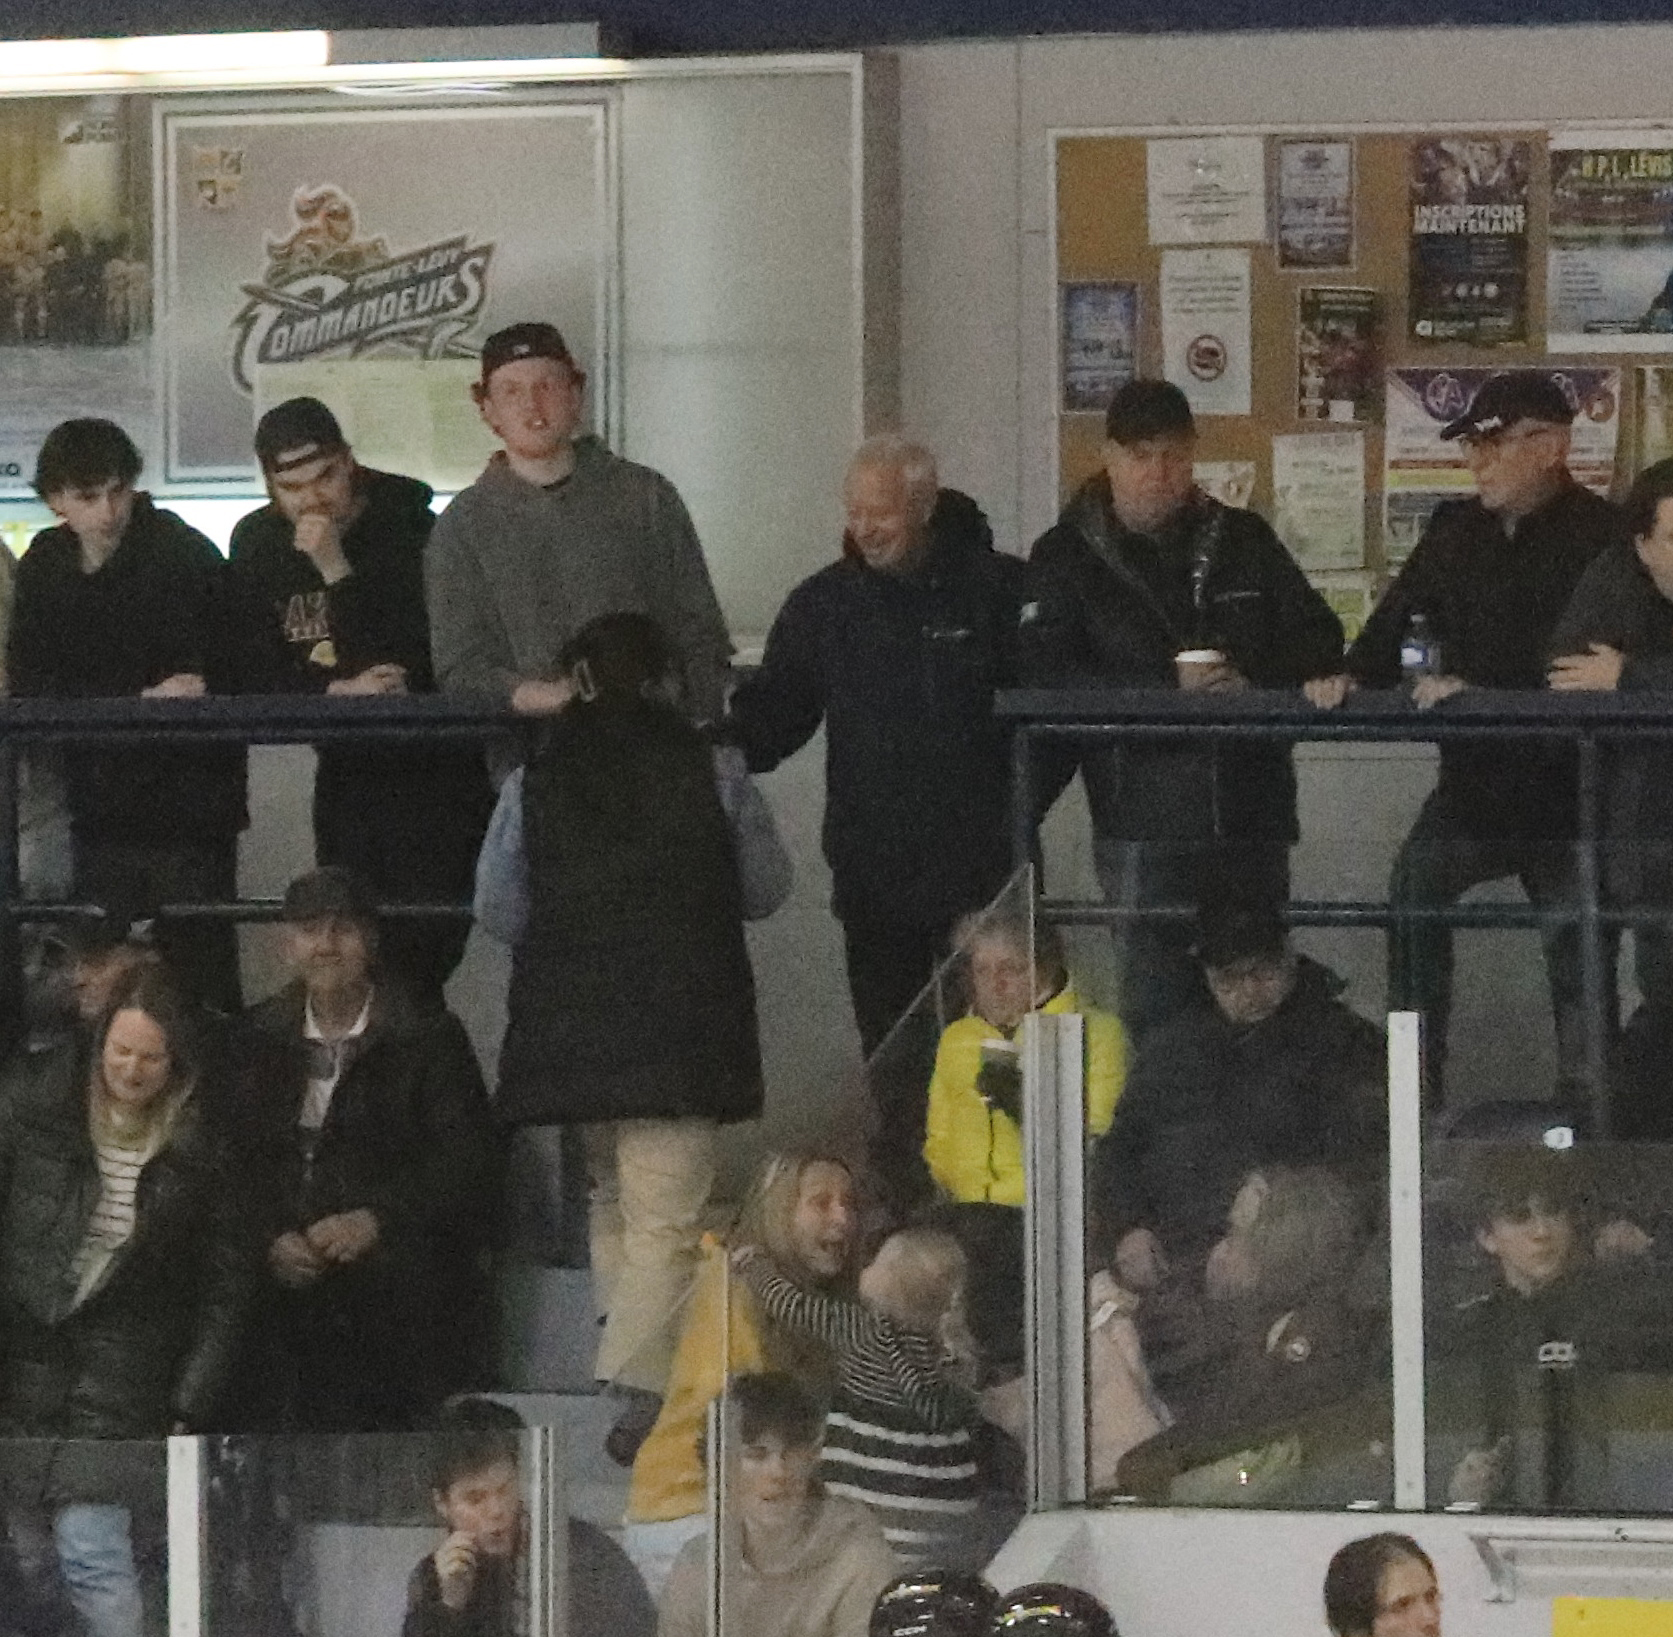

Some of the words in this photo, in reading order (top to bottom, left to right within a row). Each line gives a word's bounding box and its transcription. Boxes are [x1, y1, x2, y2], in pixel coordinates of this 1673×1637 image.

[1414, 203, 1526, 220] INSCRIPTIONS
[1413, 219, 1525, 235] MAINTENANT
[238, 255, 488, 392] COMMANDEURS
